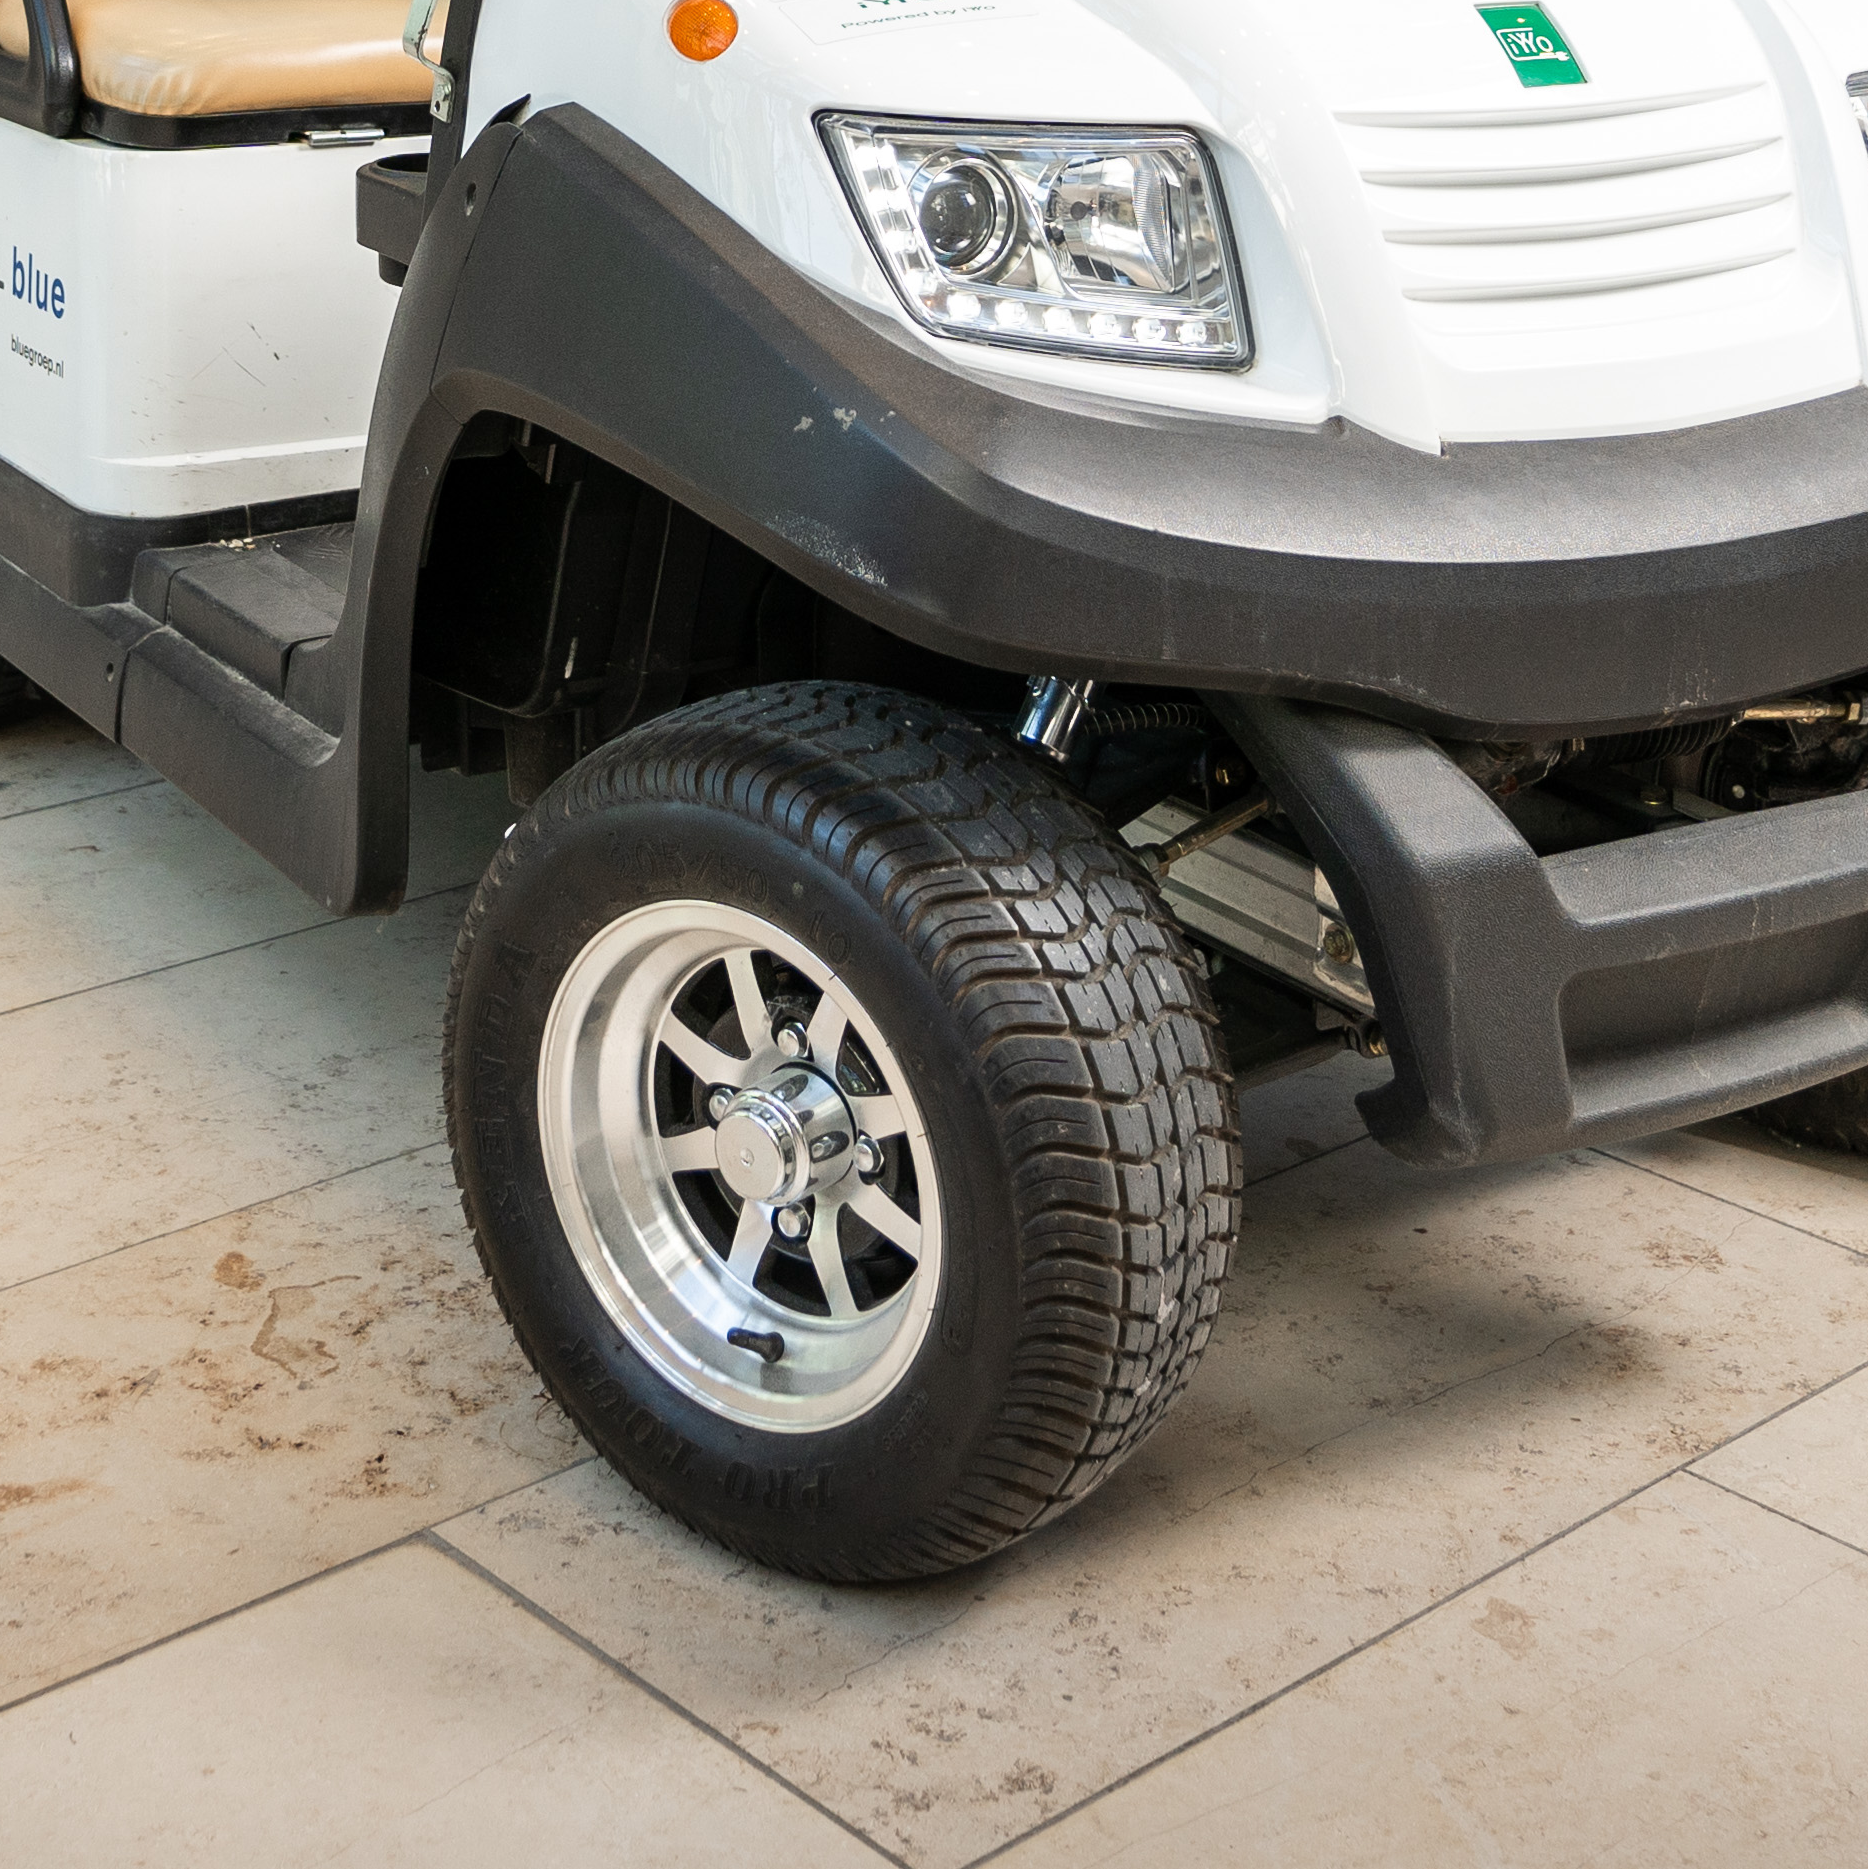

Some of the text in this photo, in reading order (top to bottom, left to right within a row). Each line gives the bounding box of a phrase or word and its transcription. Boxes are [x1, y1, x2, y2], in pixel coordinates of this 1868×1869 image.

[841, 11, 929, 29] Powered
[934, 8, 957, 16] by
[11, 245, 66, 319] blue
[11, 333, 65, 379] bluegroep.nl
[558, 1335, 835, 1512] PRO TOUR
